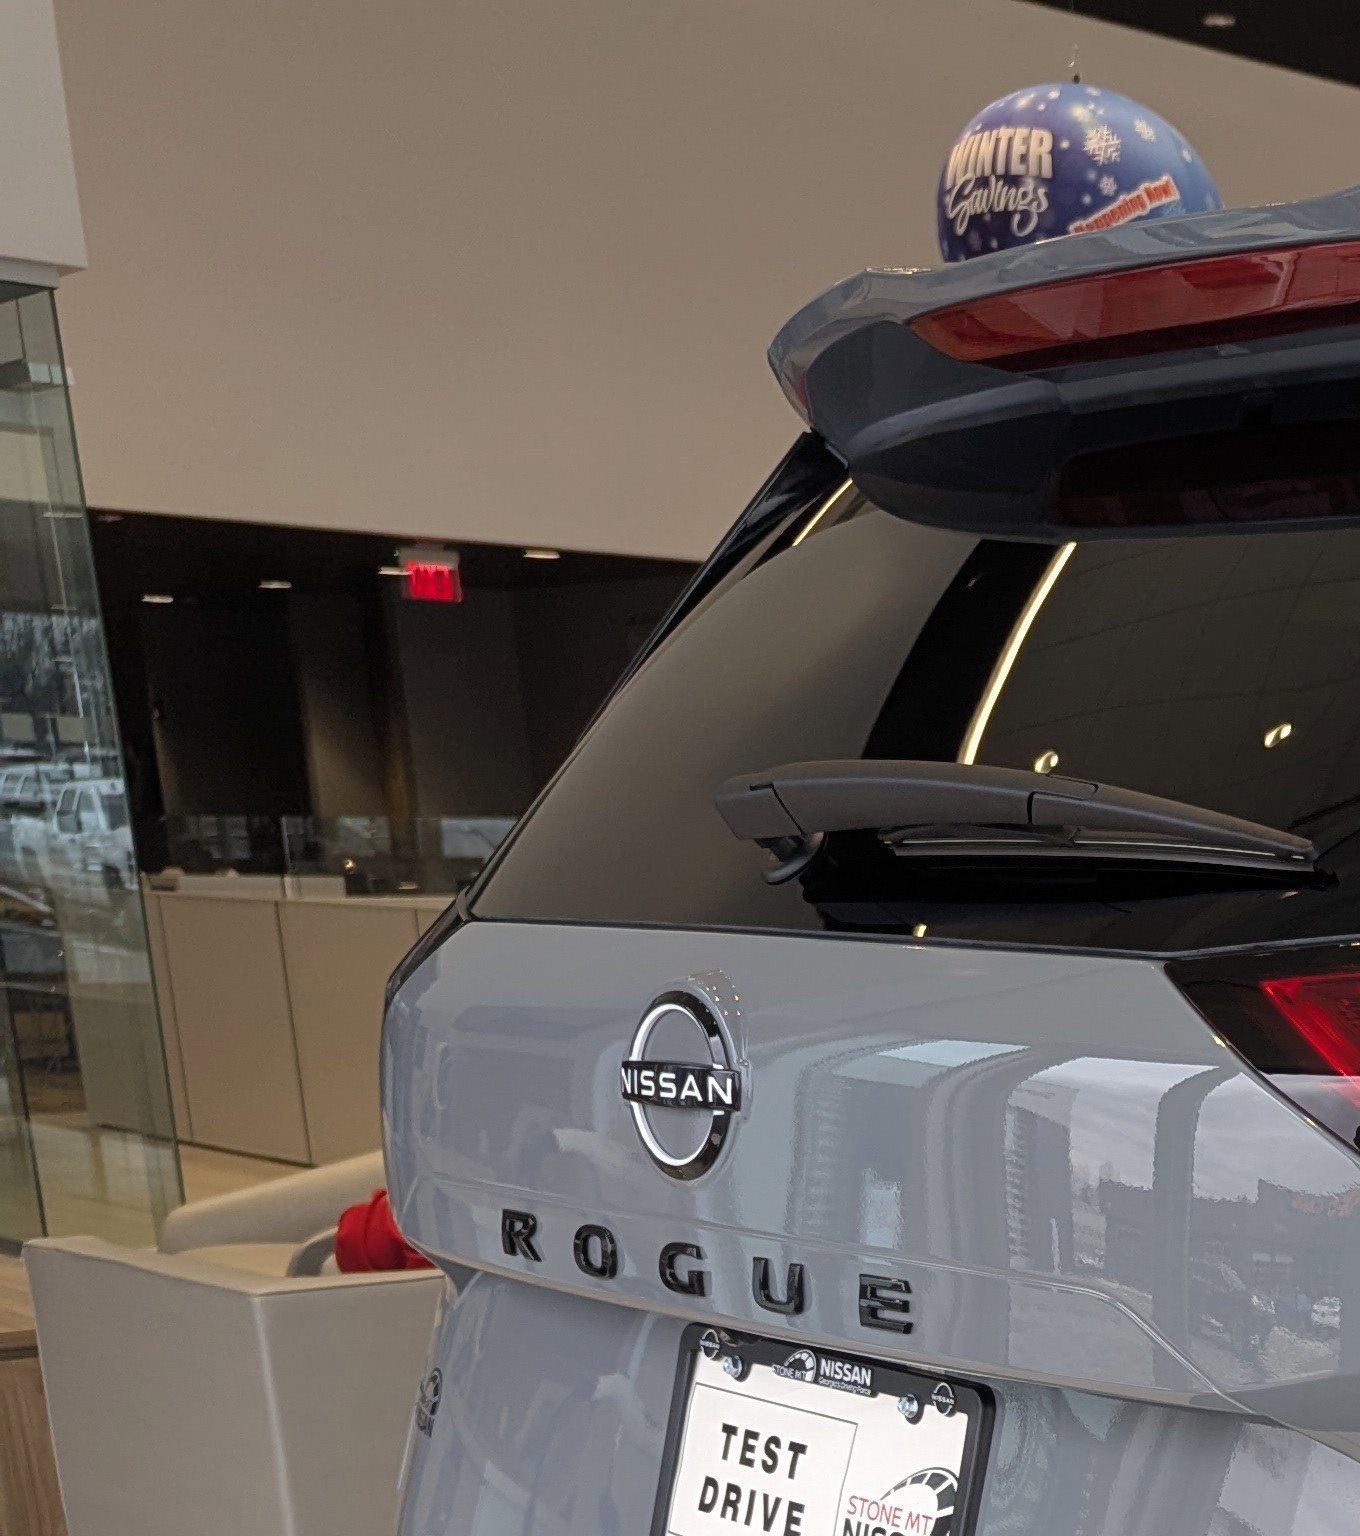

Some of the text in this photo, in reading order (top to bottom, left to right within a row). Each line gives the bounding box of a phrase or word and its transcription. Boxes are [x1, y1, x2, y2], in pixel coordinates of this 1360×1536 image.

[946, 127, 1053, 191] WINTER
[947, 174, 1049, 236] Savings
[621, 1067, 733, 1105] NISSAN
[501, 1208, 913, 1336] ROGUE
[820, 1358, 873, 1388] NISSAN
[721, 1422, 808, 1480] TEST
[846, 1495, 934, 1536] STONE MT
